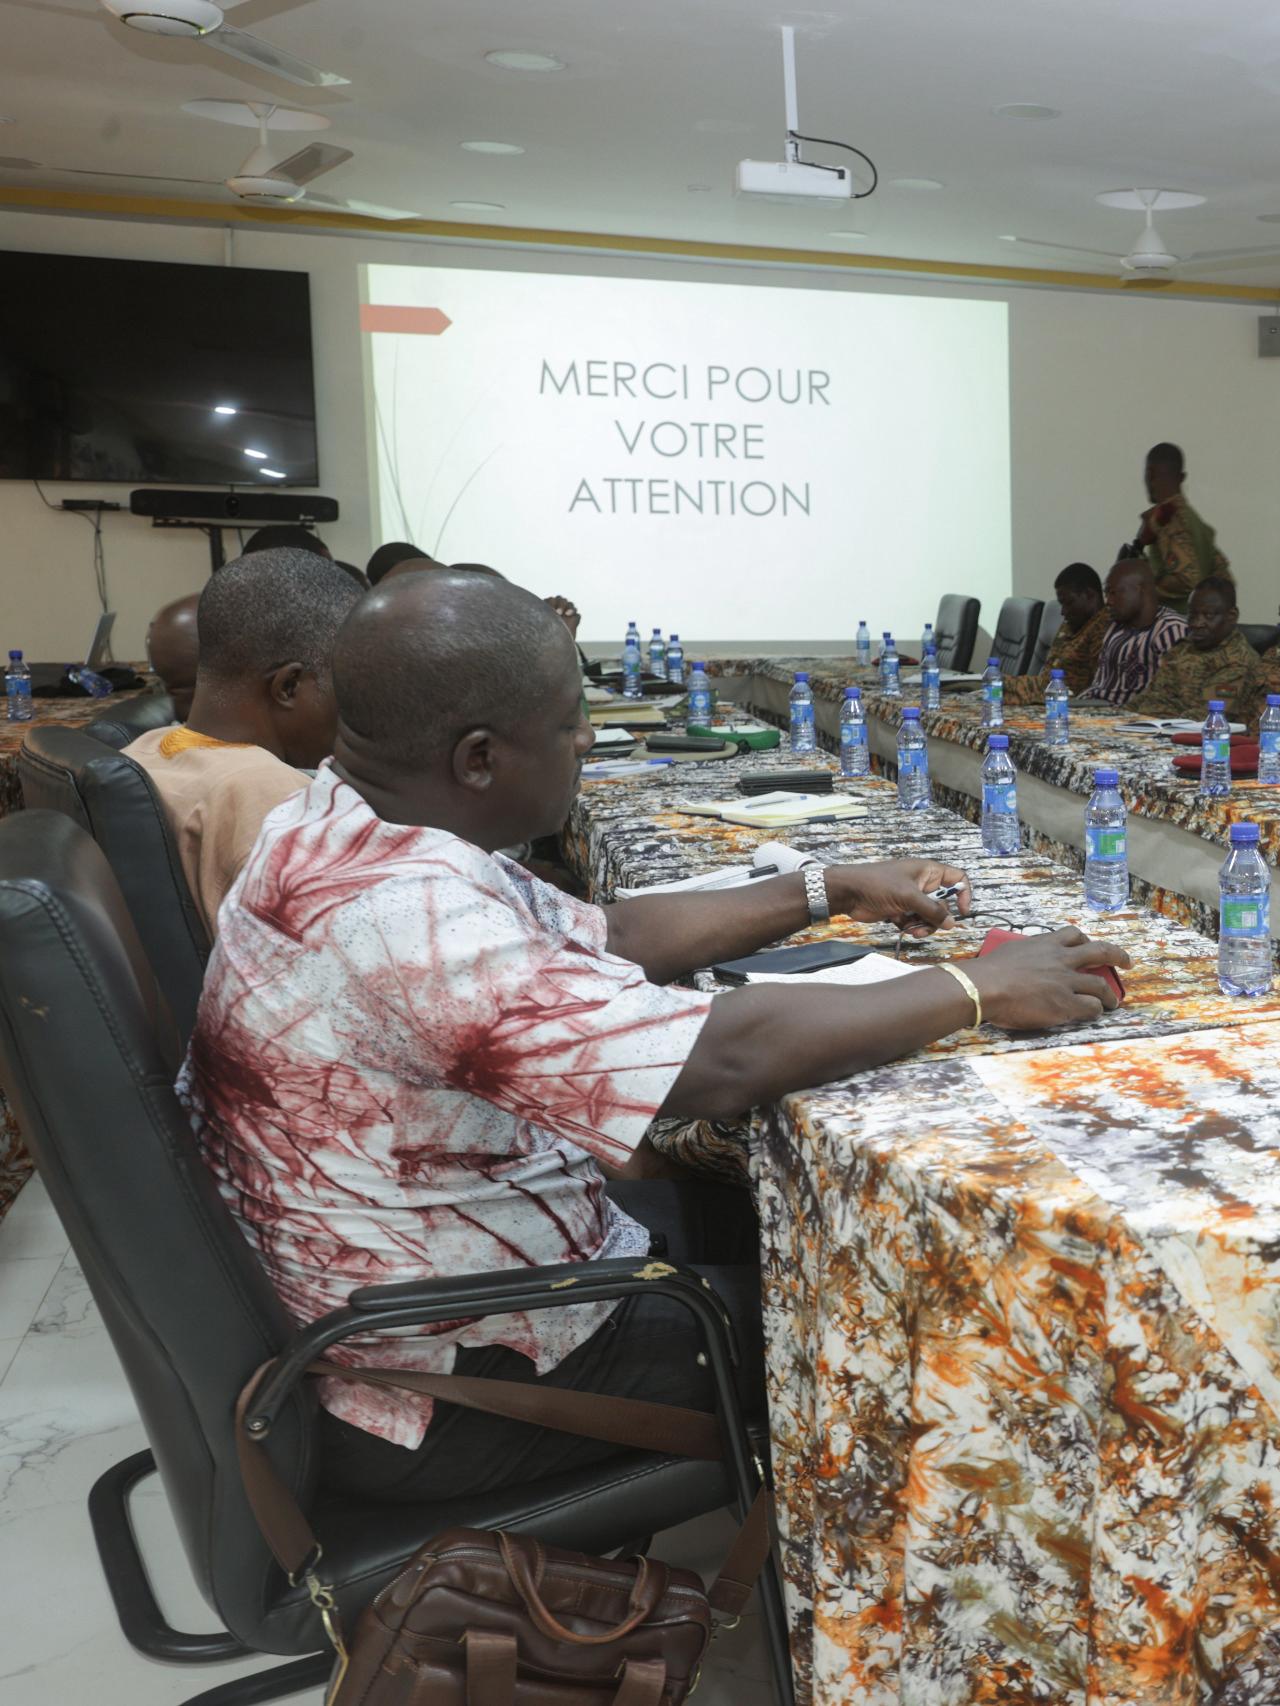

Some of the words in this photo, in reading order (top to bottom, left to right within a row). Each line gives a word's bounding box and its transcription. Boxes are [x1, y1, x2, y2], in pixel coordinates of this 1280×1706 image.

[540, 359, 688, 399] MERCI
[708, 366, 830, 405] POUR
[615, 420, 764, 459] VOTRE
[568, 478, 810, 516] ATTENTION
